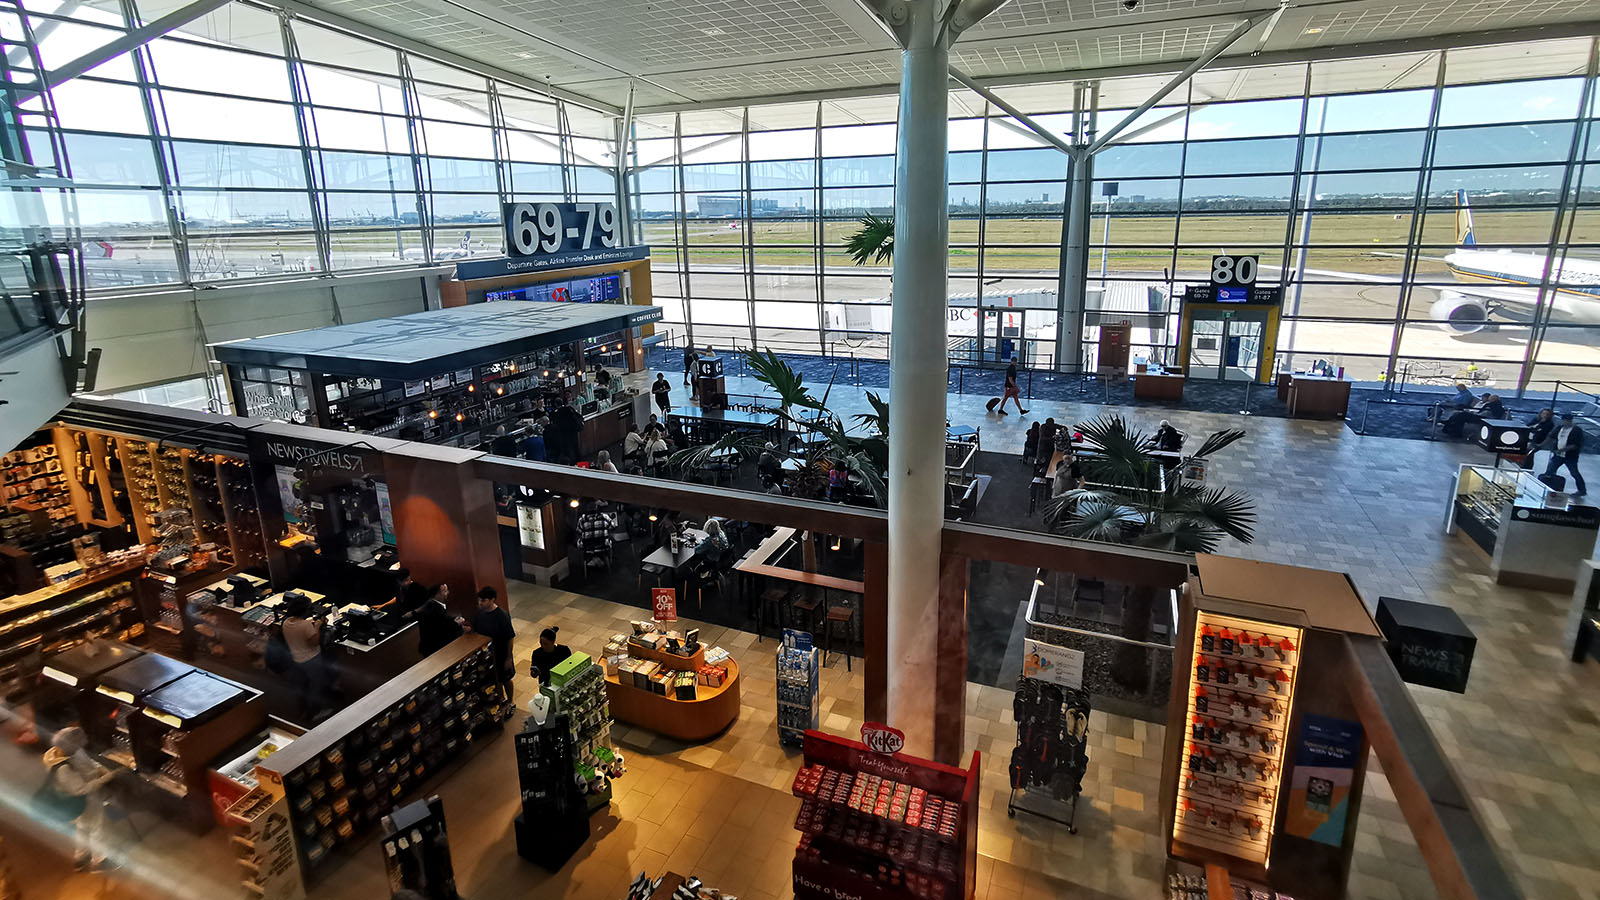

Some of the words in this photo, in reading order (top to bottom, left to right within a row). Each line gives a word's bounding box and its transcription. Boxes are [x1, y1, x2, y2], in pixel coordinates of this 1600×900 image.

[513, 203, 619, 255] 69-79
[507, 261, 533, 270] Departure
[550, 257, 565, 265] Airline
[1212, 256, 1257, 284] 80
[947, 308, 970, 321] BC
[656, 595, 673, 604] 10%
[1401, 642, 1449, 660] NEWS
[867, 730, 901, 751] KitKat
[859, 755, 877, 766] Treat
[795, 874, 822, 891] Have
